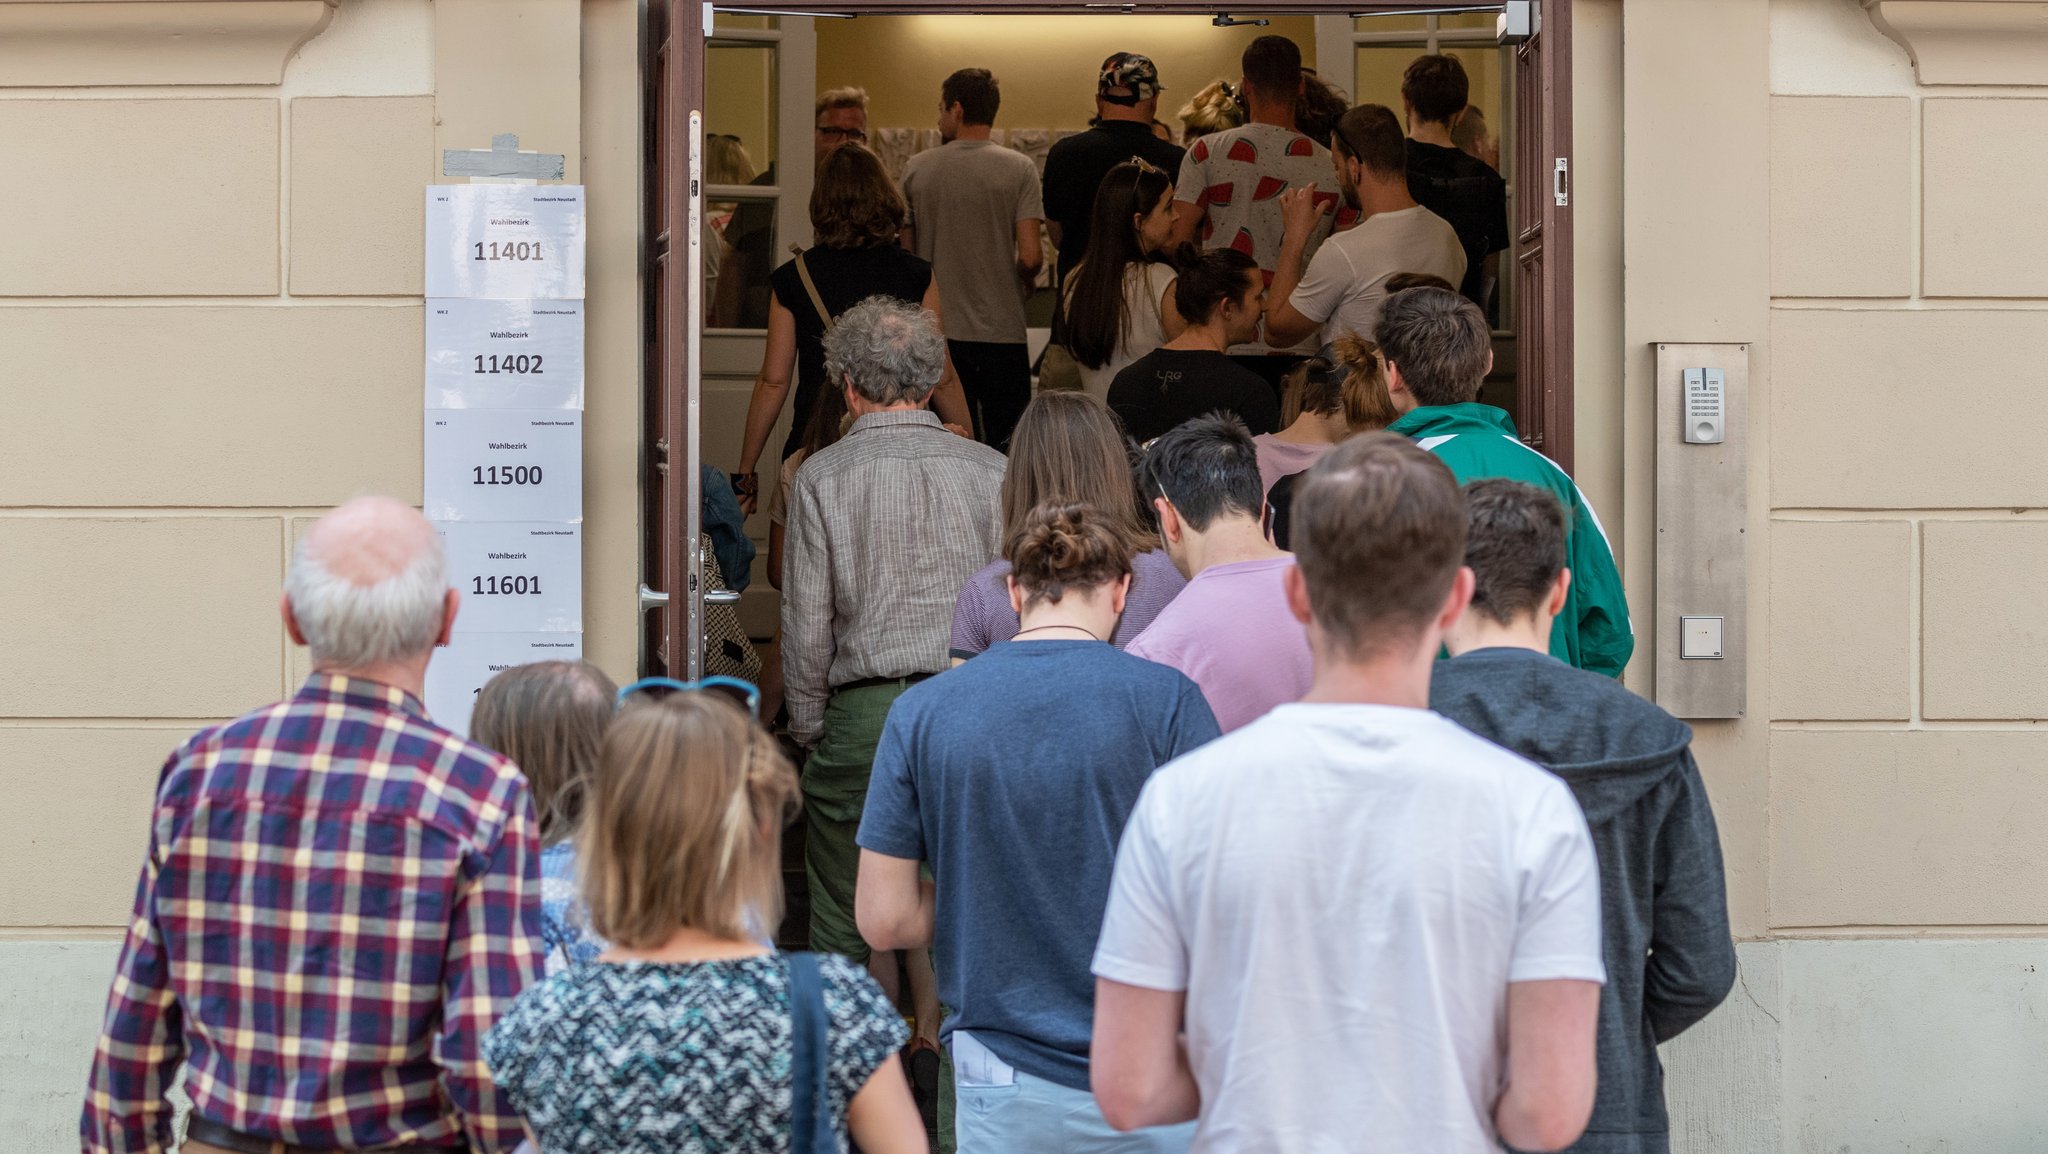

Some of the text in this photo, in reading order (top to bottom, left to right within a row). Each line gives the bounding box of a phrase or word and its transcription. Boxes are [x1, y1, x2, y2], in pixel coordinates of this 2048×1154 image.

[490, 218, 530, 226] Wahlbezirk
[474, 241, 544, 261] 11401
[490, 331, 529, 339] Wahlbezirk
[474, 354, 544, 374] 11402
[488, 442, 528, 450] Wahlbezirk
[473, 465, 543, 486] 11500
[488, 552, 527, 560] Wahlbezirk
[472, 575, 542, 596] 11601
